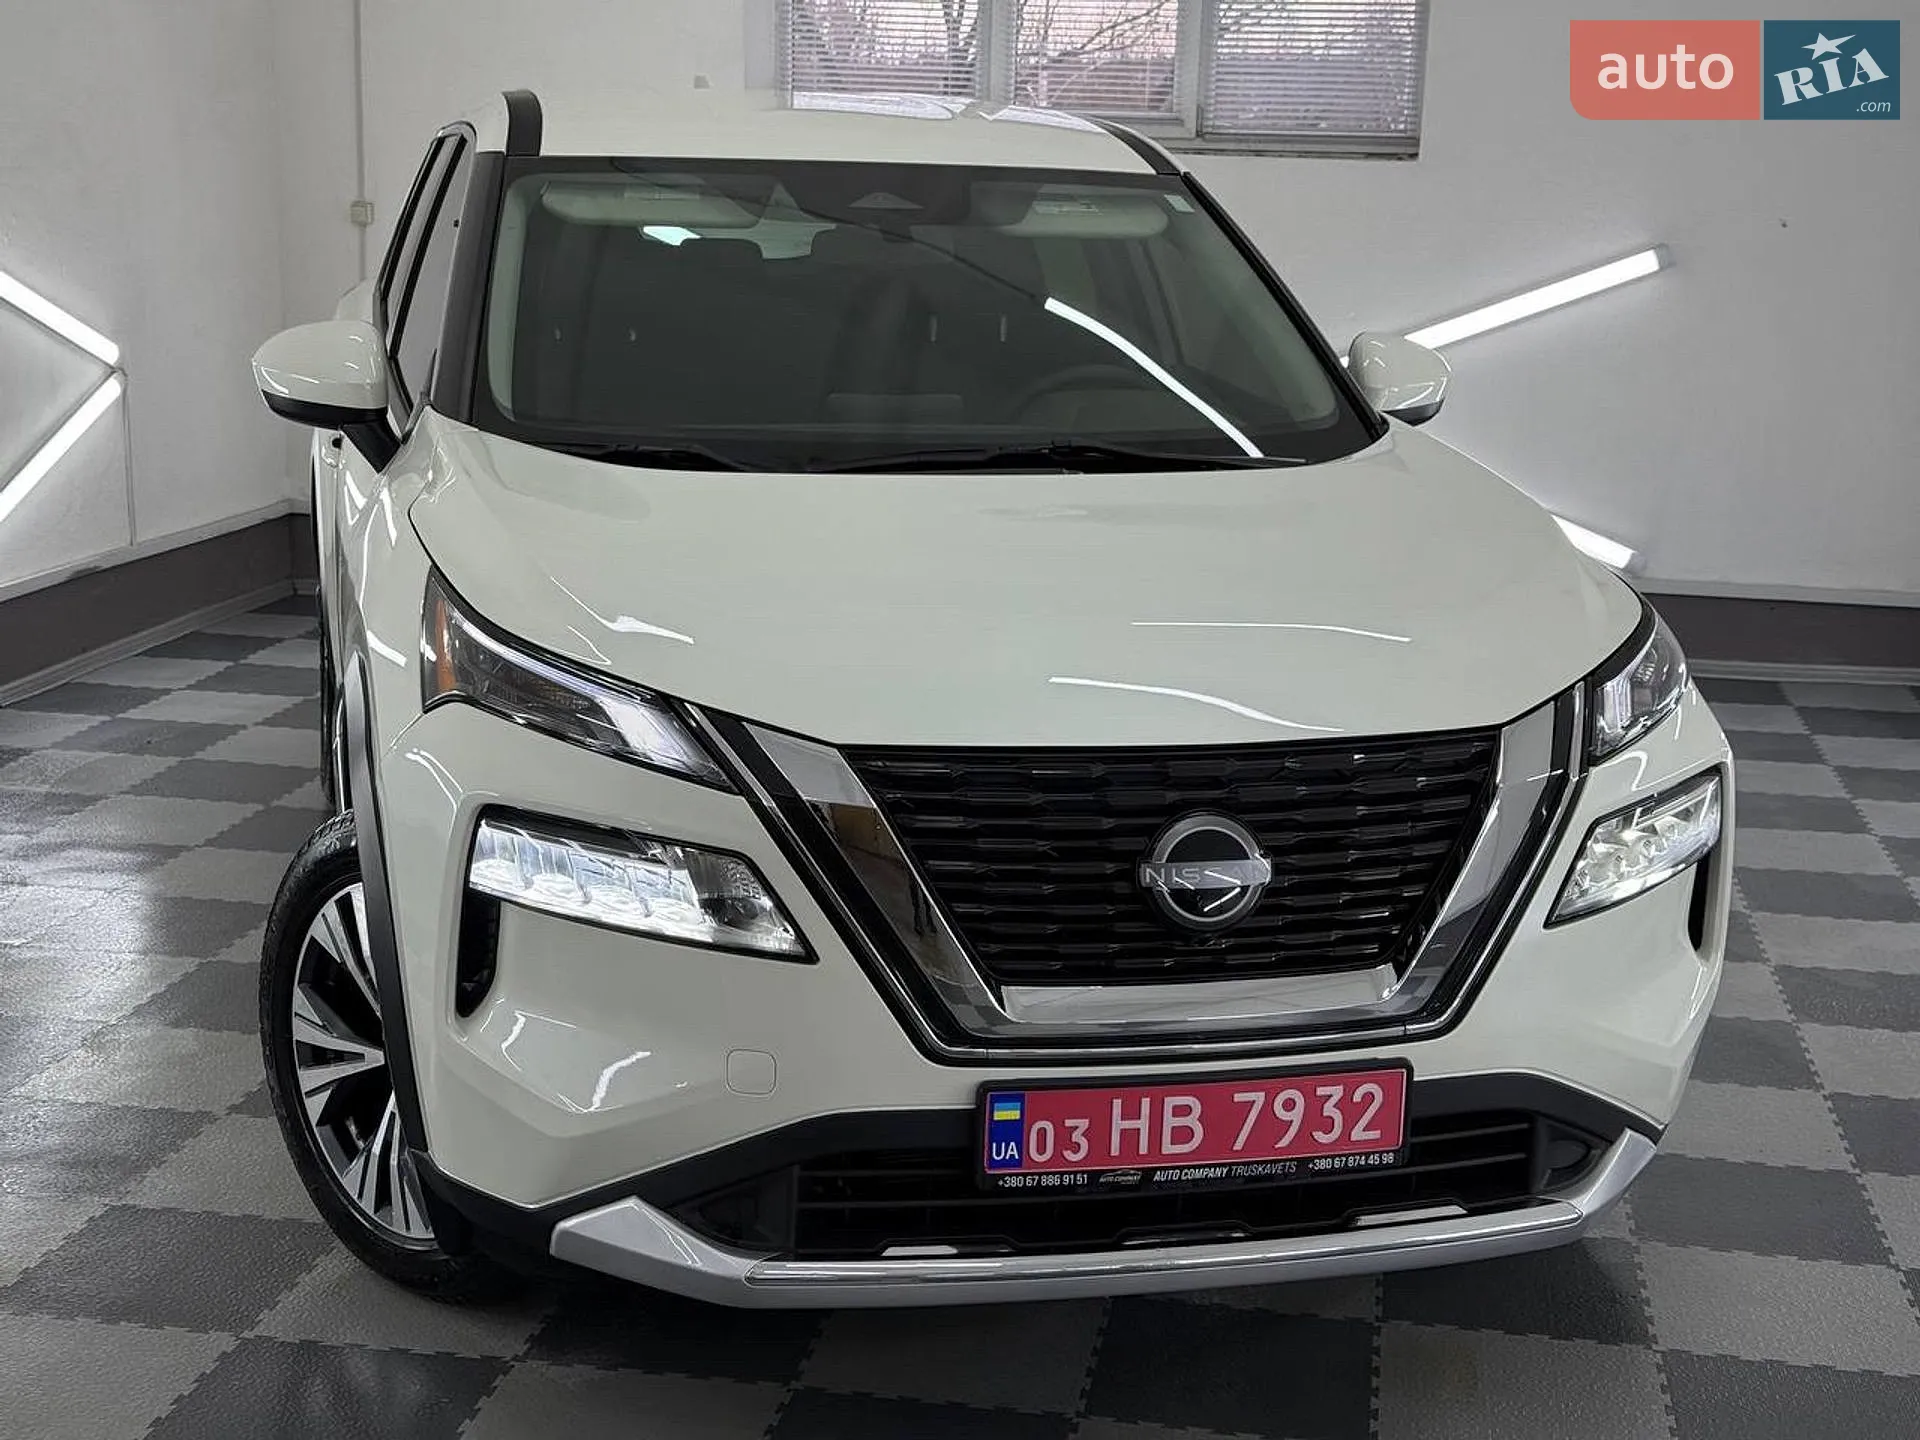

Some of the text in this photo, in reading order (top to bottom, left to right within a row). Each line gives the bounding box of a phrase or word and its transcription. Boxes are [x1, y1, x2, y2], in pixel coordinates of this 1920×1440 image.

[1029, 1083, 1384, 1162] 03 HB 7932
[992, 1141, 1019, 1160] UA
[1153, 1161, 1298, 1182] AUTO COMPANY TRUSKAVETS
[1308, 1158, 1332, 1170] +380
[1333, 1157, 1346, 1168] 67
[1347, 1156, 1366, 1167] 874
[1367, 1154, 1380, 1165] 45
[998, 1176, 1024, 1188] +380
[1026, 1176, 1038, 1187] 67
